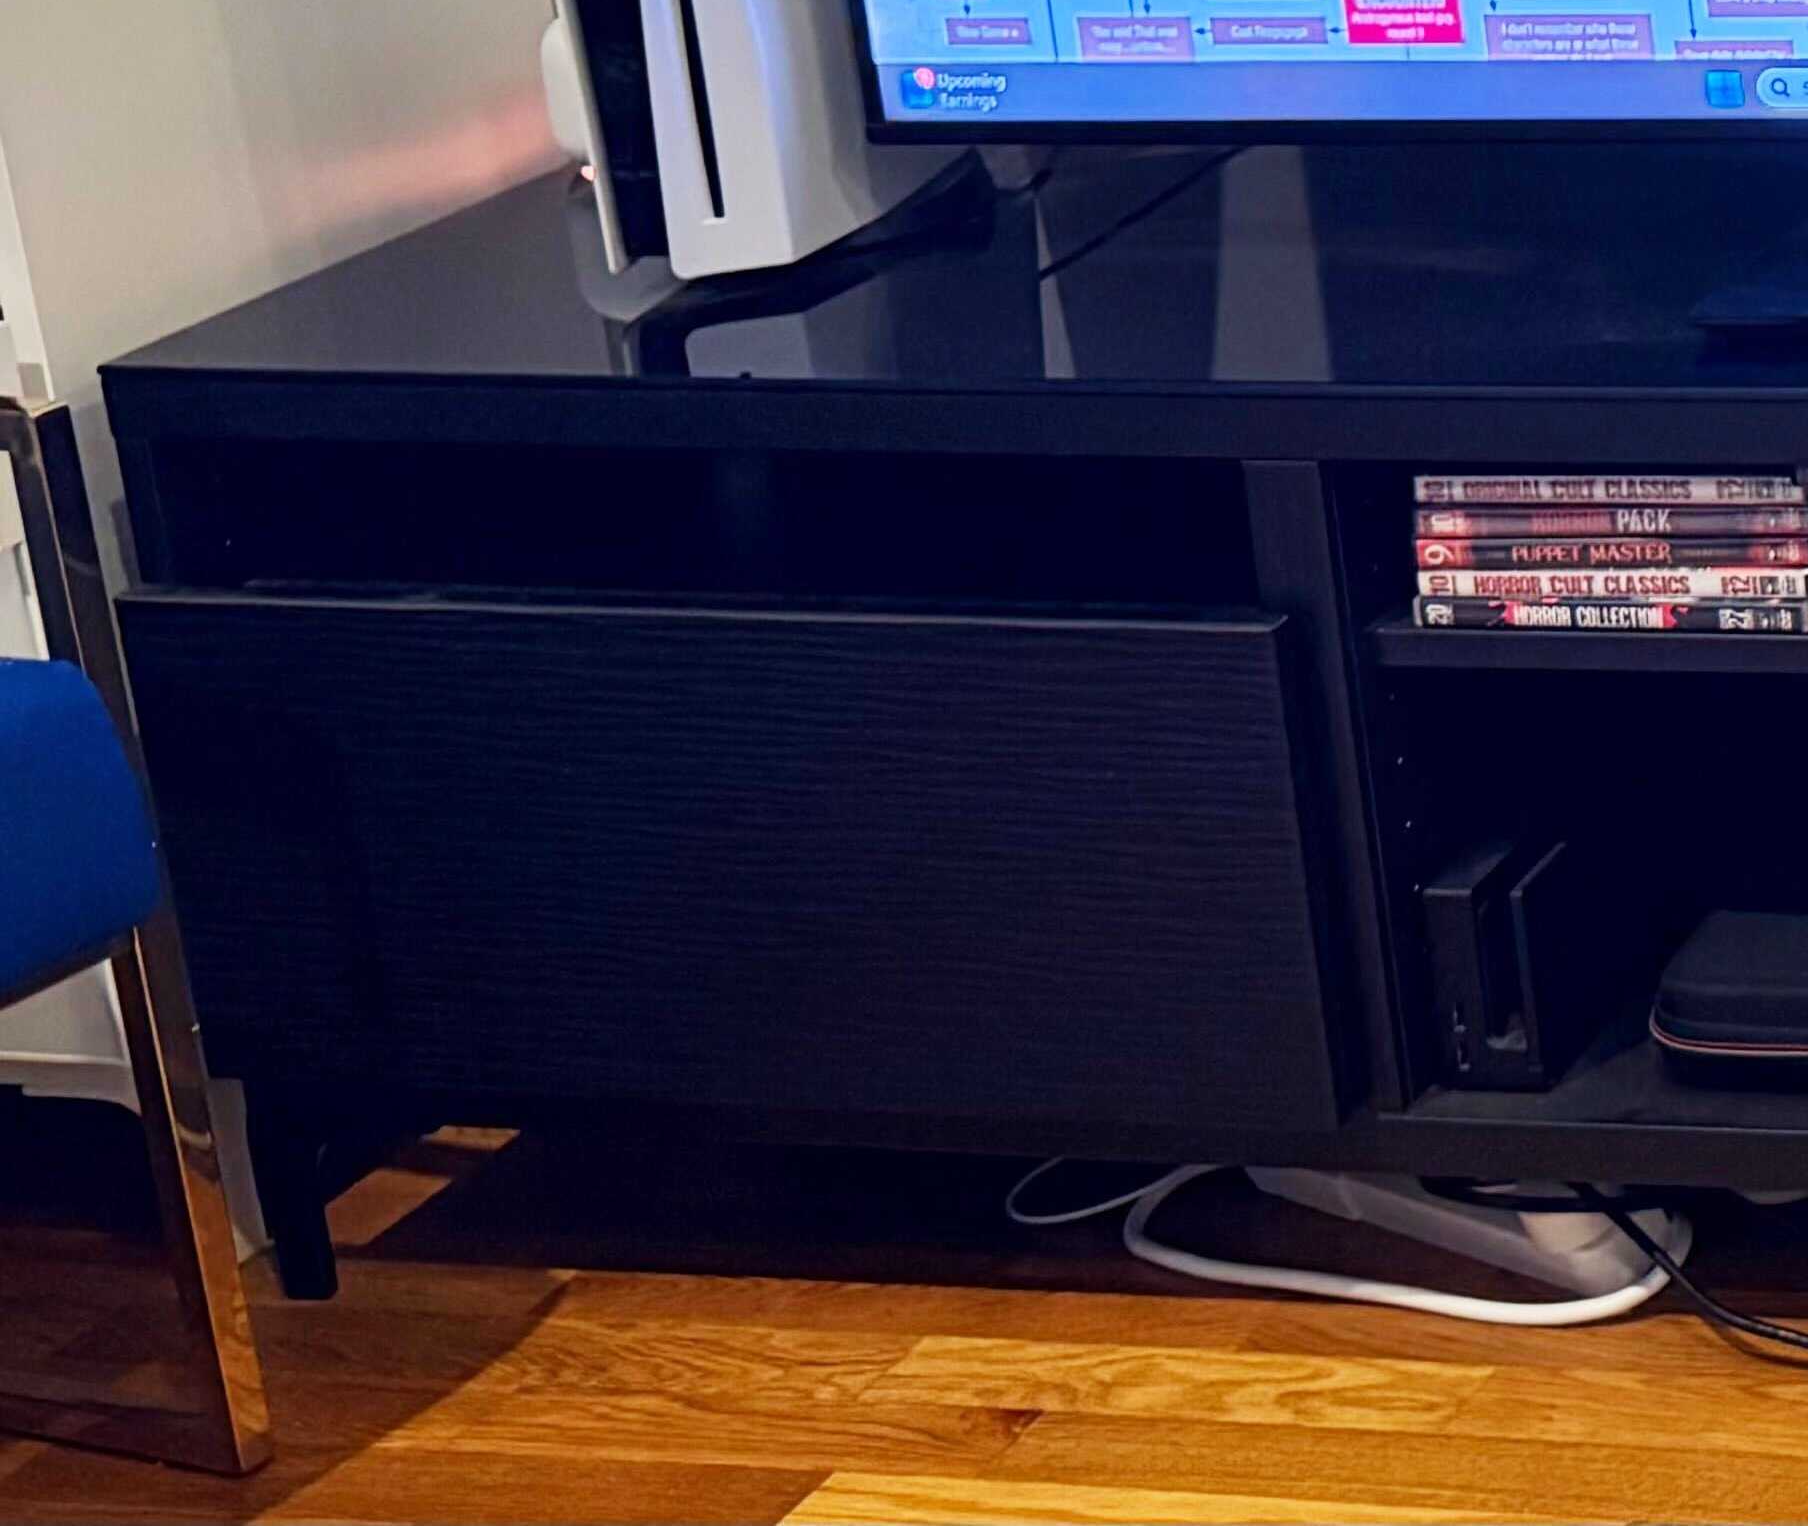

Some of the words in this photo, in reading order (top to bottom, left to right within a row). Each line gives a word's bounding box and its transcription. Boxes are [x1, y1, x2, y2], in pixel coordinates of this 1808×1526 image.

[938, 73, 1006, 93] Upcoming
[939, 93, 998, 112] Earnings
[1463, 481, 1542, 501] ORIGINAL
[1551, 480, 1596, 501] CULT
[1604, 480, 1692, 499] CLASSICS
[1617, 509, 1672, 532] PACK
[1512, 545, 1582, 563] PUPPET
[1590, 543, 1672, 562] MASTER
[1474, 576, 1542, 595] HORROR
[1551, 576, 1595, 594] CULT
[1604, 575, 1690, 594] CLASSICS
[1513, 605, 1571, 626] HORROR
[1576, 605, 1663, 626] COLLECTION
